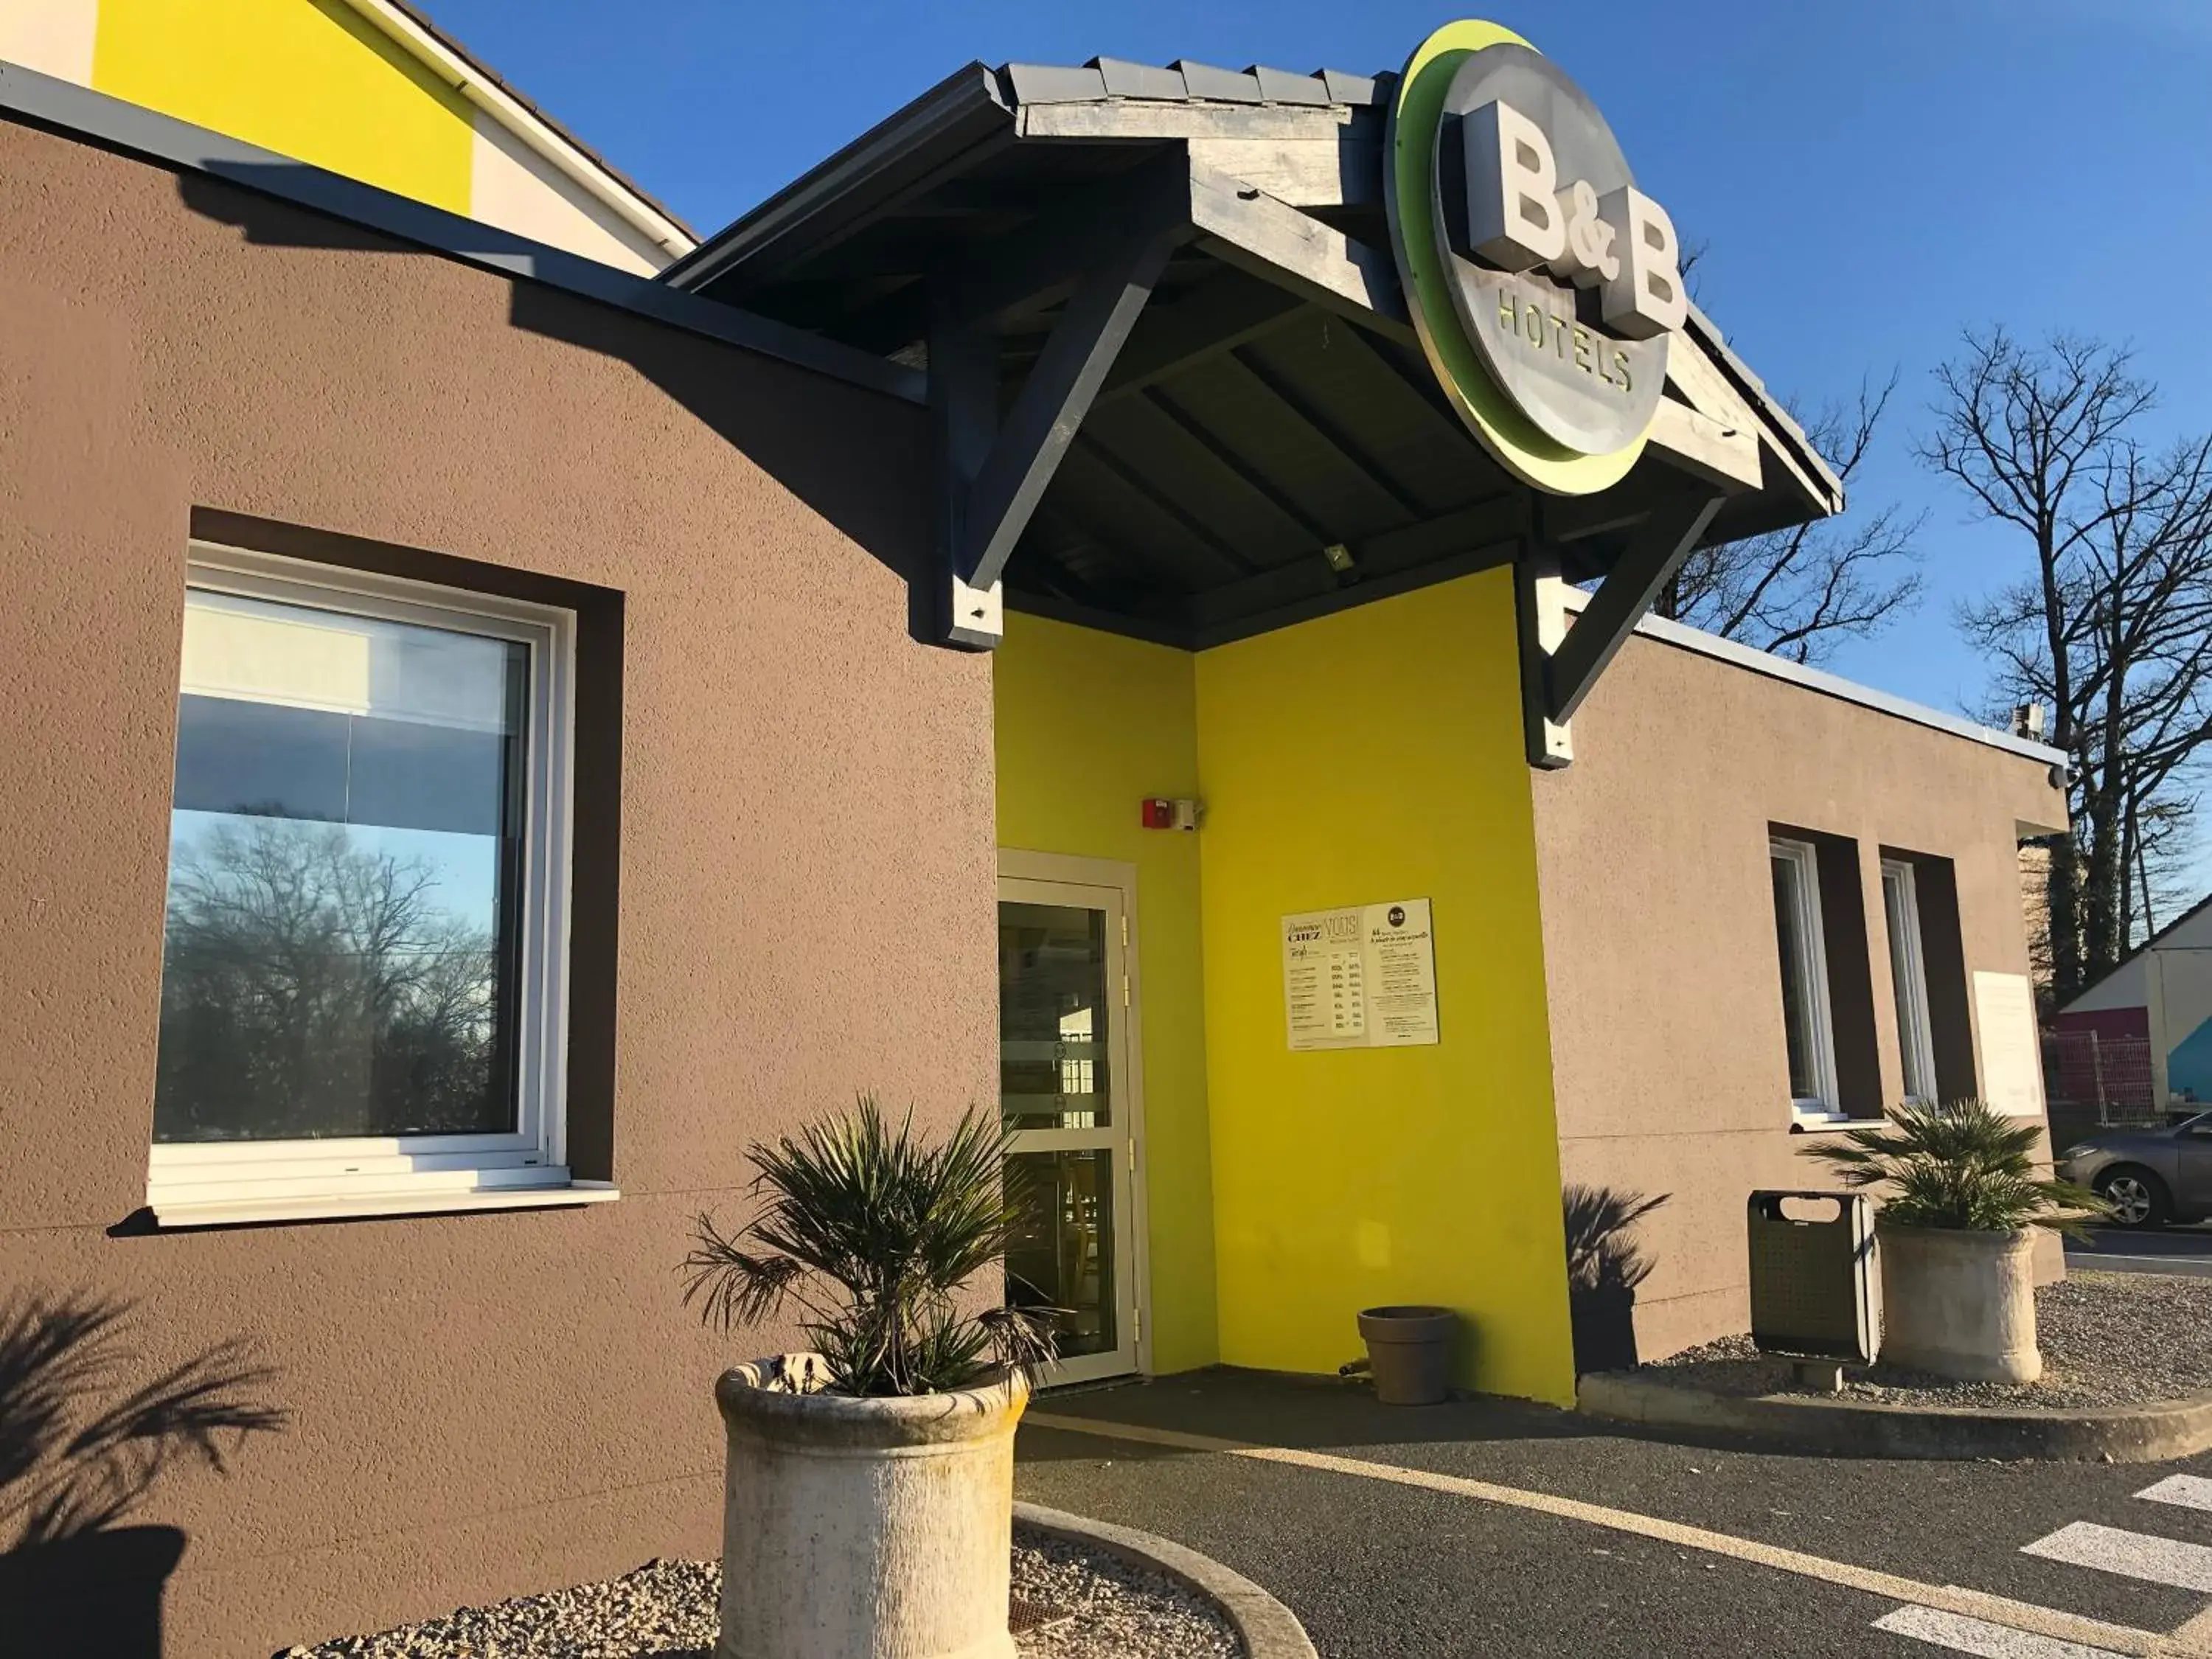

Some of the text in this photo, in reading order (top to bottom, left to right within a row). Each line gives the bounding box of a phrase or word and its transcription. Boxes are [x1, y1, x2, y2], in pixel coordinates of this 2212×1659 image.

[1492, 100, 1688, 335] B&B
[1498, 287, 1632, 393] HOTELS
[1287, 931, 1321, 944] CHEZ
